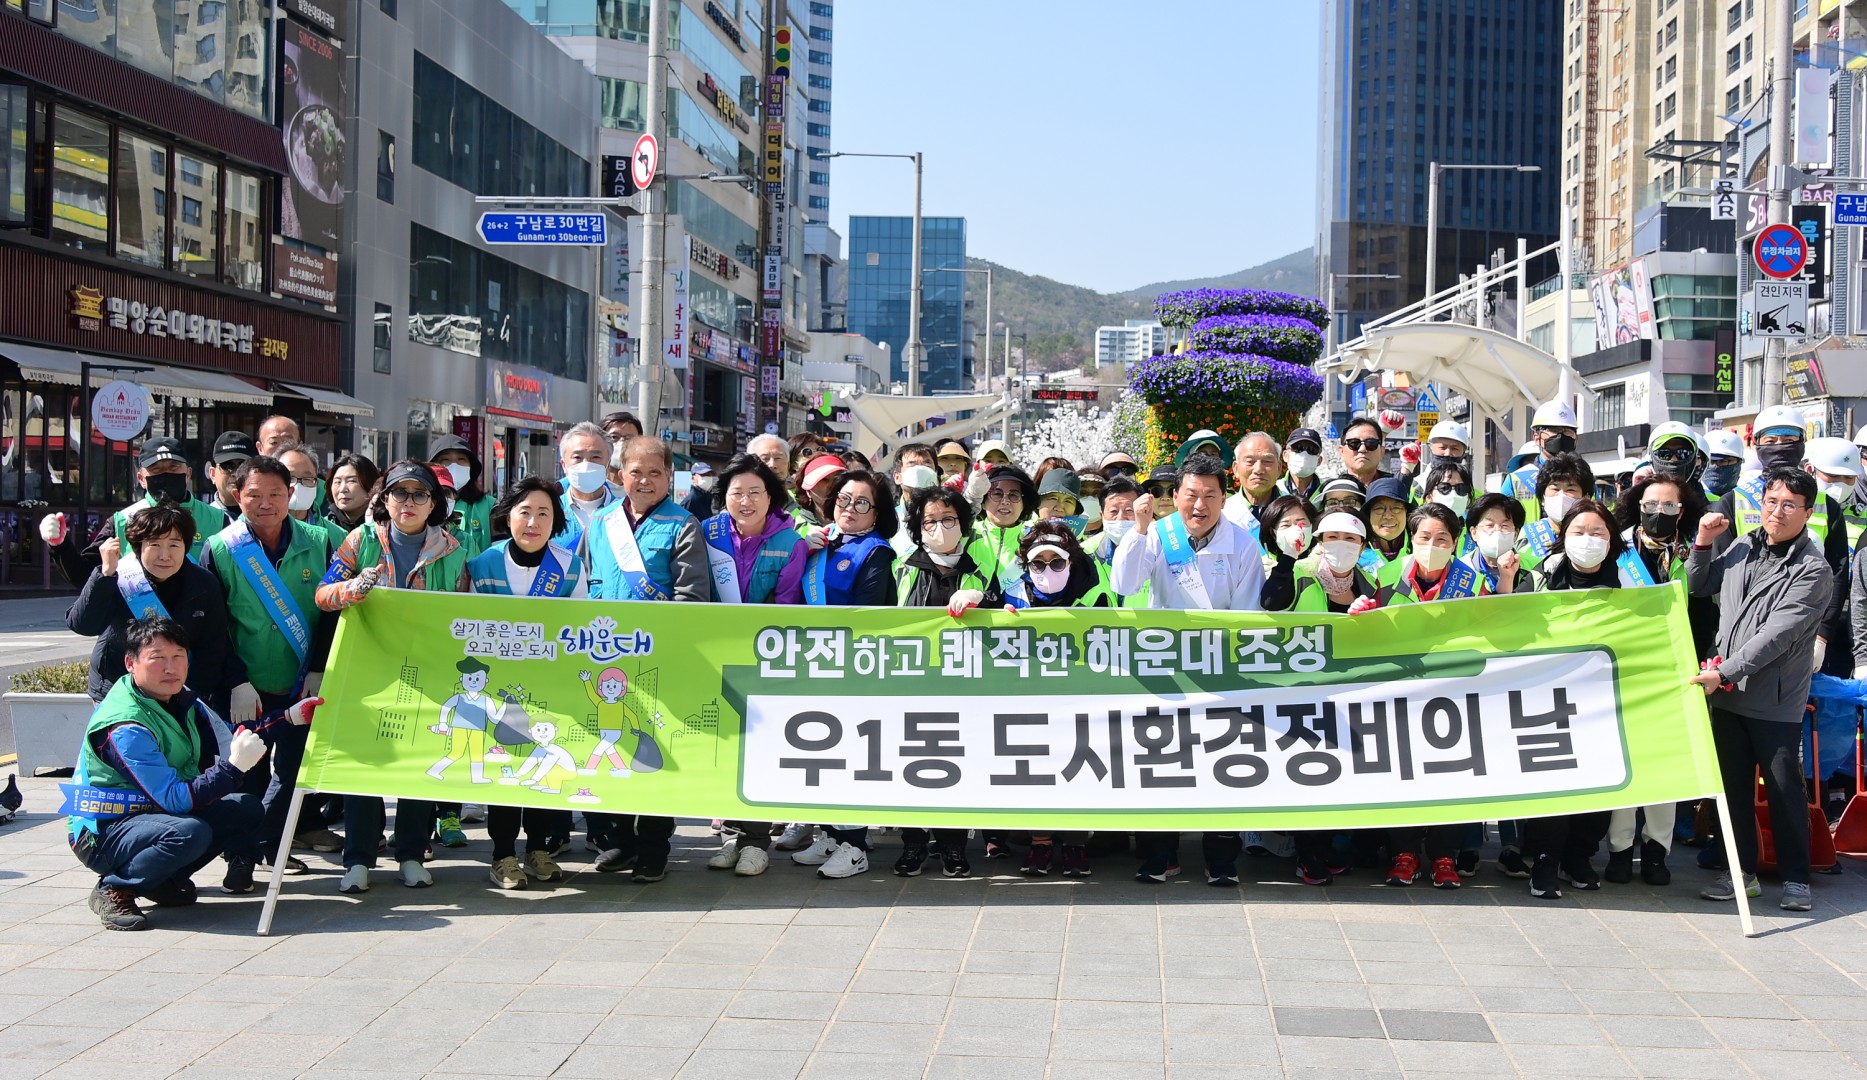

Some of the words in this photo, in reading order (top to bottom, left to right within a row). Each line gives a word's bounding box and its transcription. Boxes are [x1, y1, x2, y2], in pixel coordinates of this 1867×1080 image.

[299, 31, 317, 52] SINCE
[767, 135, 782, 178] 더타이
[615, 160, 626, 195] BAR
[1802, 190, 1833, 201] BAR
[487, 222, 496, 230] 26
[515, 217, 557, 230] 구남로
[559, 217, 574, 229] 30
[577, 216, 602, 232] 번길
[517, 232, 556, 242] Gunam-ro
[558, 232, 602, 243] 30beon-gil
[1761, 246, 1801, 256] 주정차금지
[768, 257, 777, 289] 노래타운
[107, 297, 254, 354] 밀양순대돼지국밥
[549, 572, 561, 594] 구민
[1447, 567, 1460, 594] 2030
[1459, 570, 1473, 589] 구민
[453, 621, 480, 636] 살기
[485, 623, 511, 637] 좋은
[515, 624, 541, 638] 도시
[467, 642, 494, 655] 오고
[498, 642, 524, 657] 싶은
[528, 644, 554, 657] 도시
[559, 628, 651, 661] 해운대
[757, 629, 926, 679] 안전하고
[940, 628, 1072, 678] 쾌적한
[1086, 627, 1224, 677] 해운대
[1237, 624, 1328, 673] 조성
[779, 710, 966, 789] 우1동
[989, 692, 1488, 789] 도시환경정비의
[1508, 687, 1578, 773] 날
[83, 789, 125, 800] 응원합니다
[80, 800, 125, 814] 클린데이
